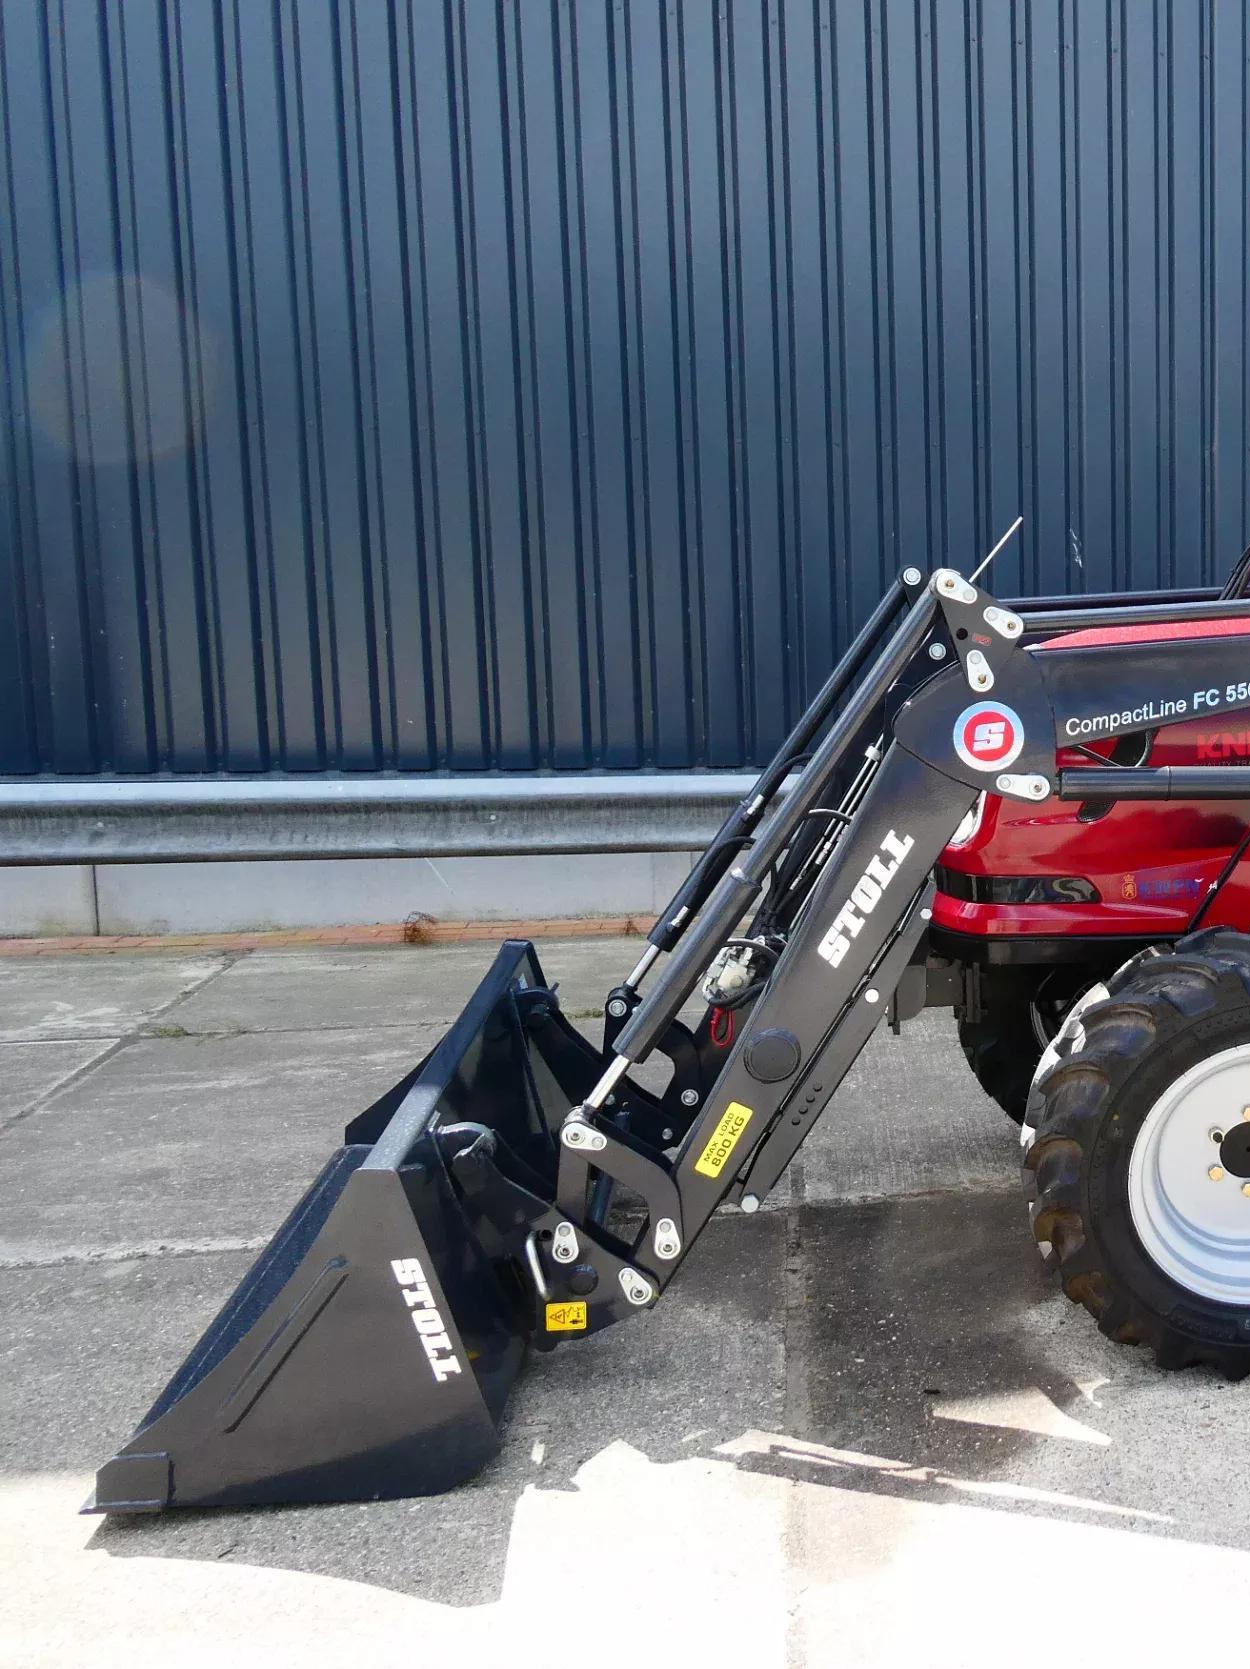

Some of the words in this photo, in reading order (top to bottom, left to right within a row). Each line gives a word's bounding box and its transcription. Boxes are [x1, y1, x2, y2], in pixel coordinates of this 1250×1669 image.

[1065, 698, 1187, 737] CompactLine
[1193, 688, 1220, 710] FC
[817, 829, 915, 968] STOLL
[703, 1141, 719, 1162] MAX
[719, 1112, 735, 1137] LOAD
[711, 1138, 732, 1167] 800
[728, 1115, 745, 1137] KG
[390, 1257, 462, 1383] STOLL
